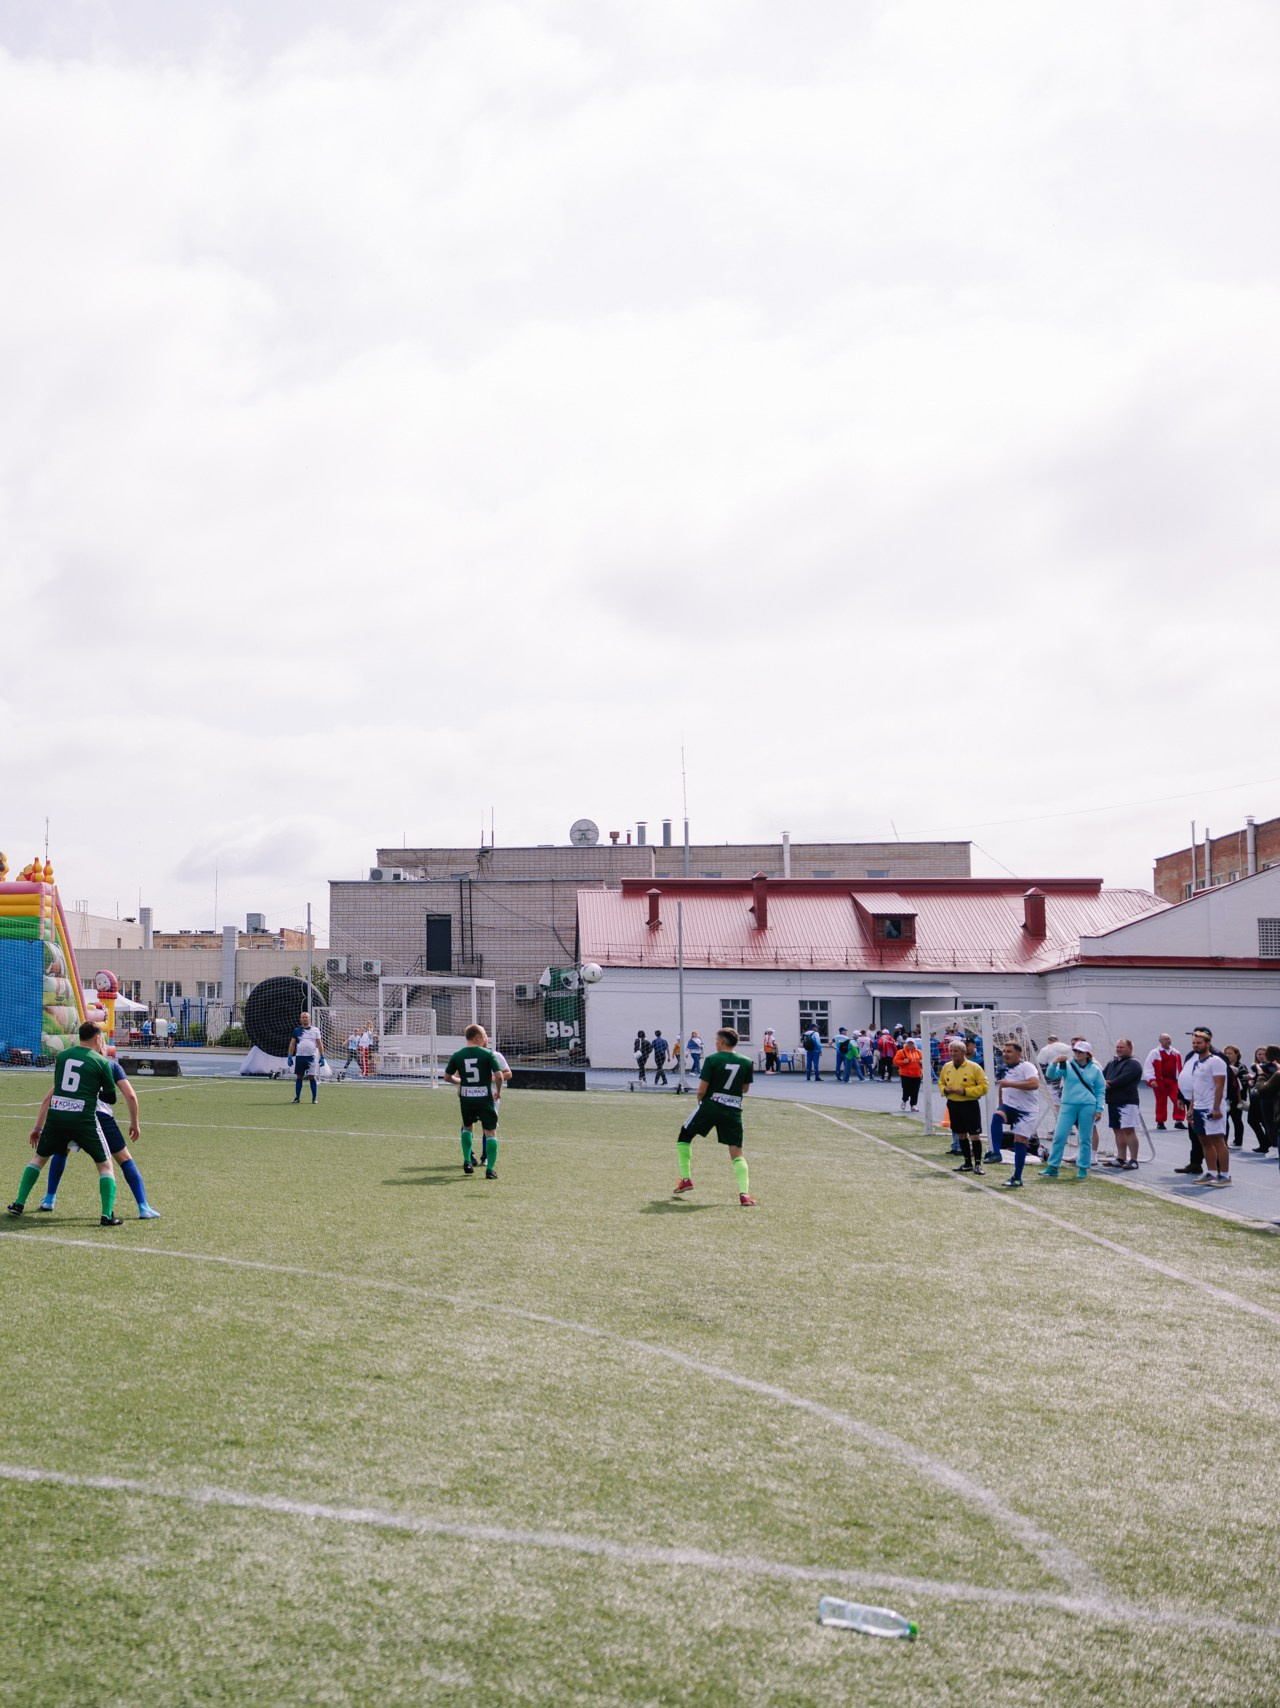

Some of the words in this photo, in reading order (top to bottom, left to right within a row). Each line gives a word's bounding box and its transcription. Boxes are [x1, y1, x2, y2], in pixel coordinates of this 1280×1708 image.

[61, 1058, 85, 1092] 6
[464, 1058, 480, 1083] 5
[723, 1063, 741, 1090] 7
